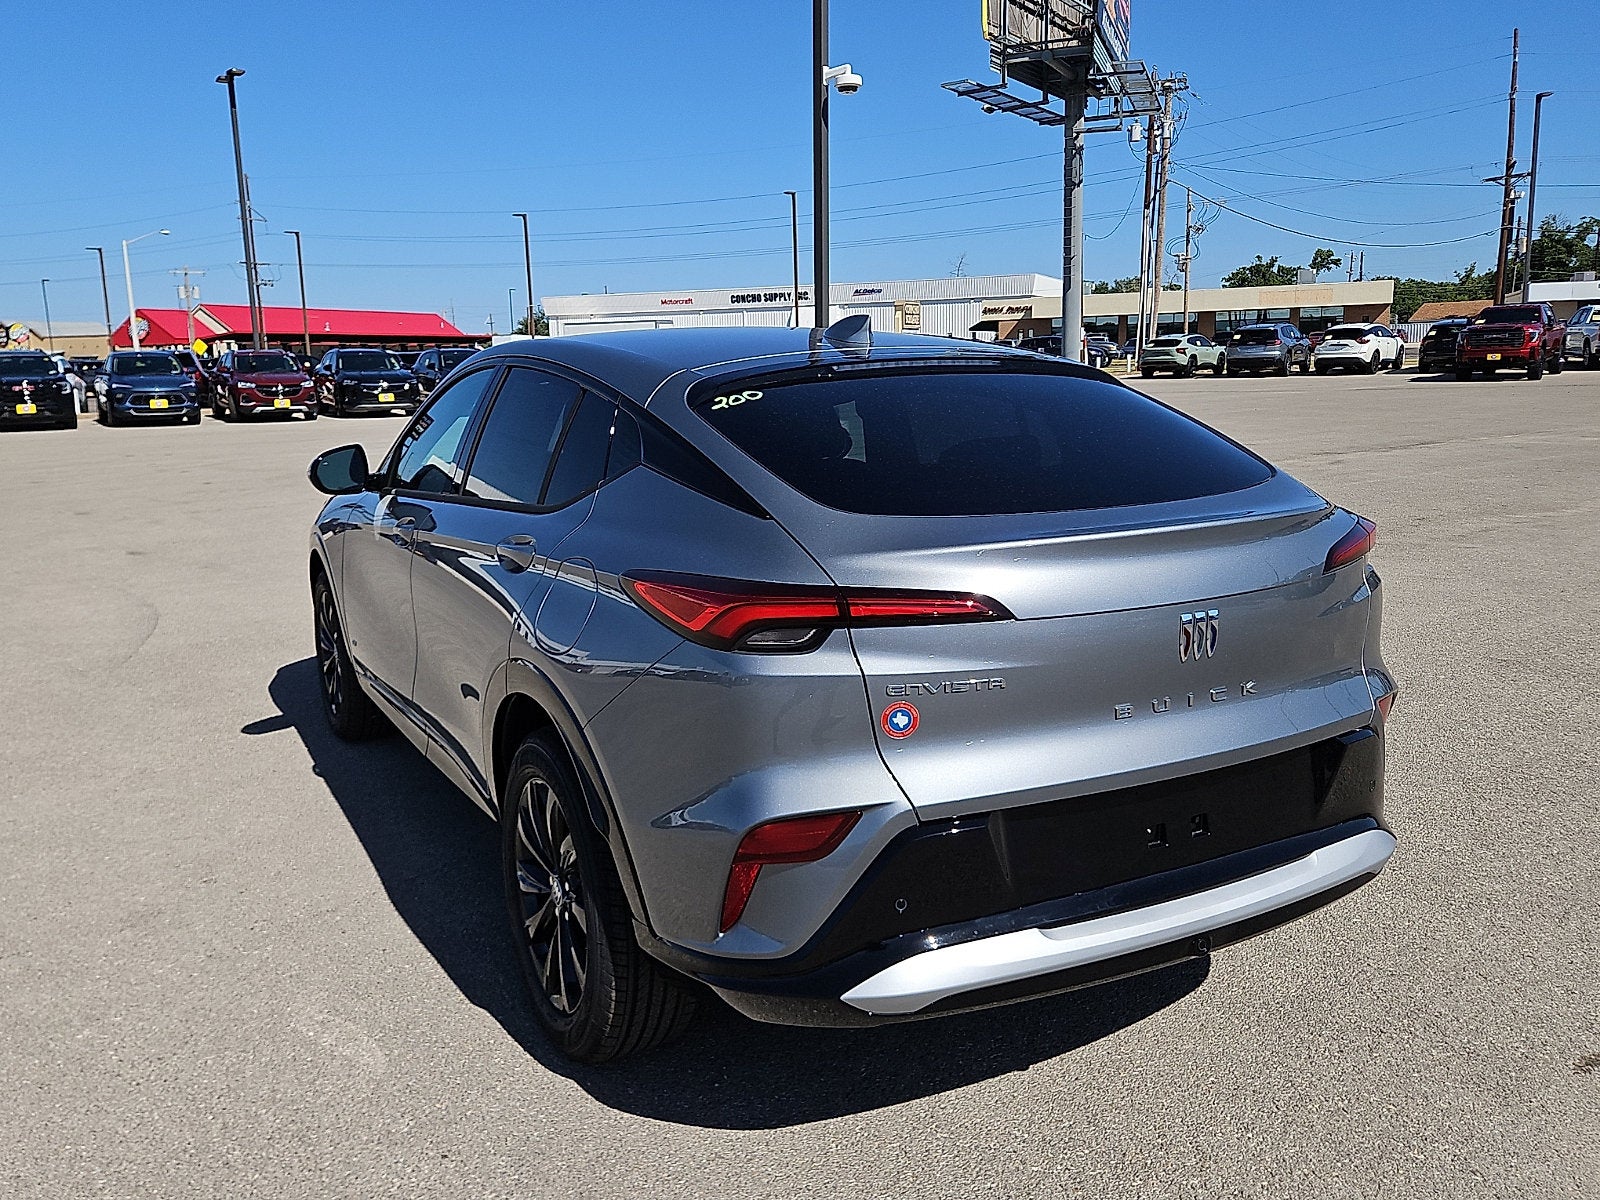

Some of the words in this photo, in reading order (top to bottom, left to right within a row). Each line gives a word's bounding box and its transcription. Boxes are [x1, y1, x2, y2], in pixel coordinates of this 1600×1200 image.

[660, 298, 694, 306] Motorcraft
[730, 293, 762, 304] CONCHO
[763, 291, 794, 303] SUPPLY,
[711, 390, 764, 410] 200
[885, 677, 1006, 698] ENVISTA
[1114, 679, 1259, 721] BUICK
